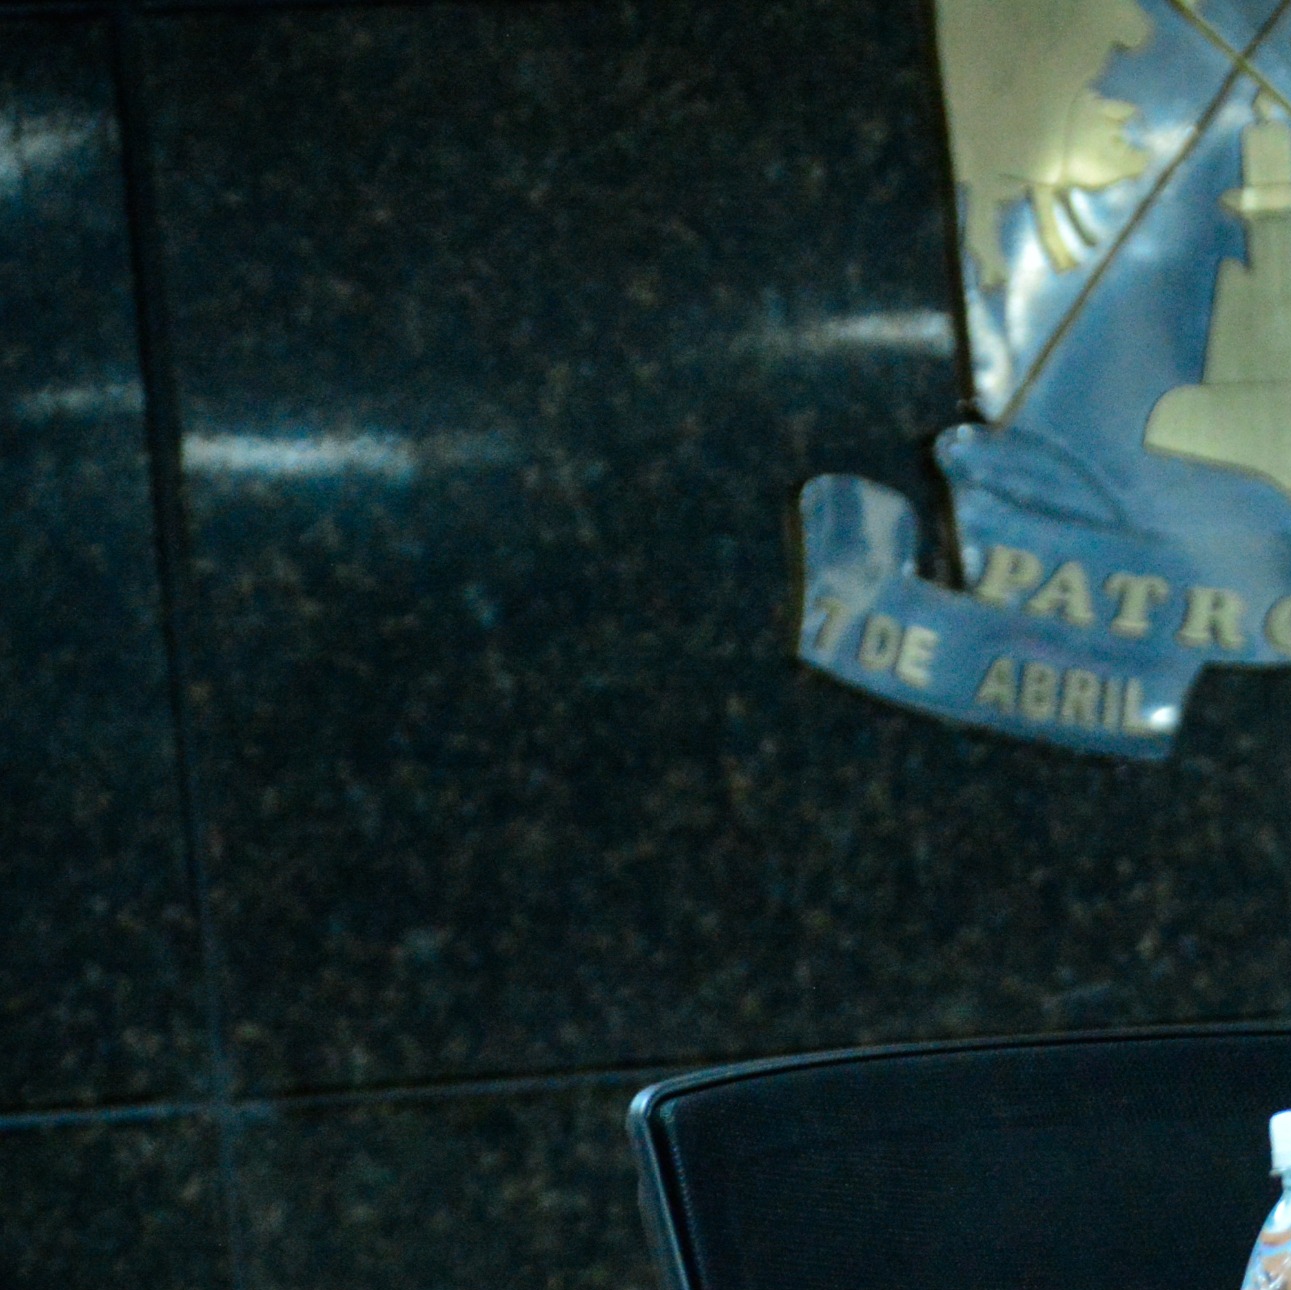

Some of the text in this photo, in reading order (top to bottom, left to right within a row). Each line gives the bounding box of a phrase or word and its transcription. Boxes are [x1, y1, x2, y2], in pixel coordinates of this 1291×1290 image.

[811, 596, 1178, 735] 7 DE ABRIL
